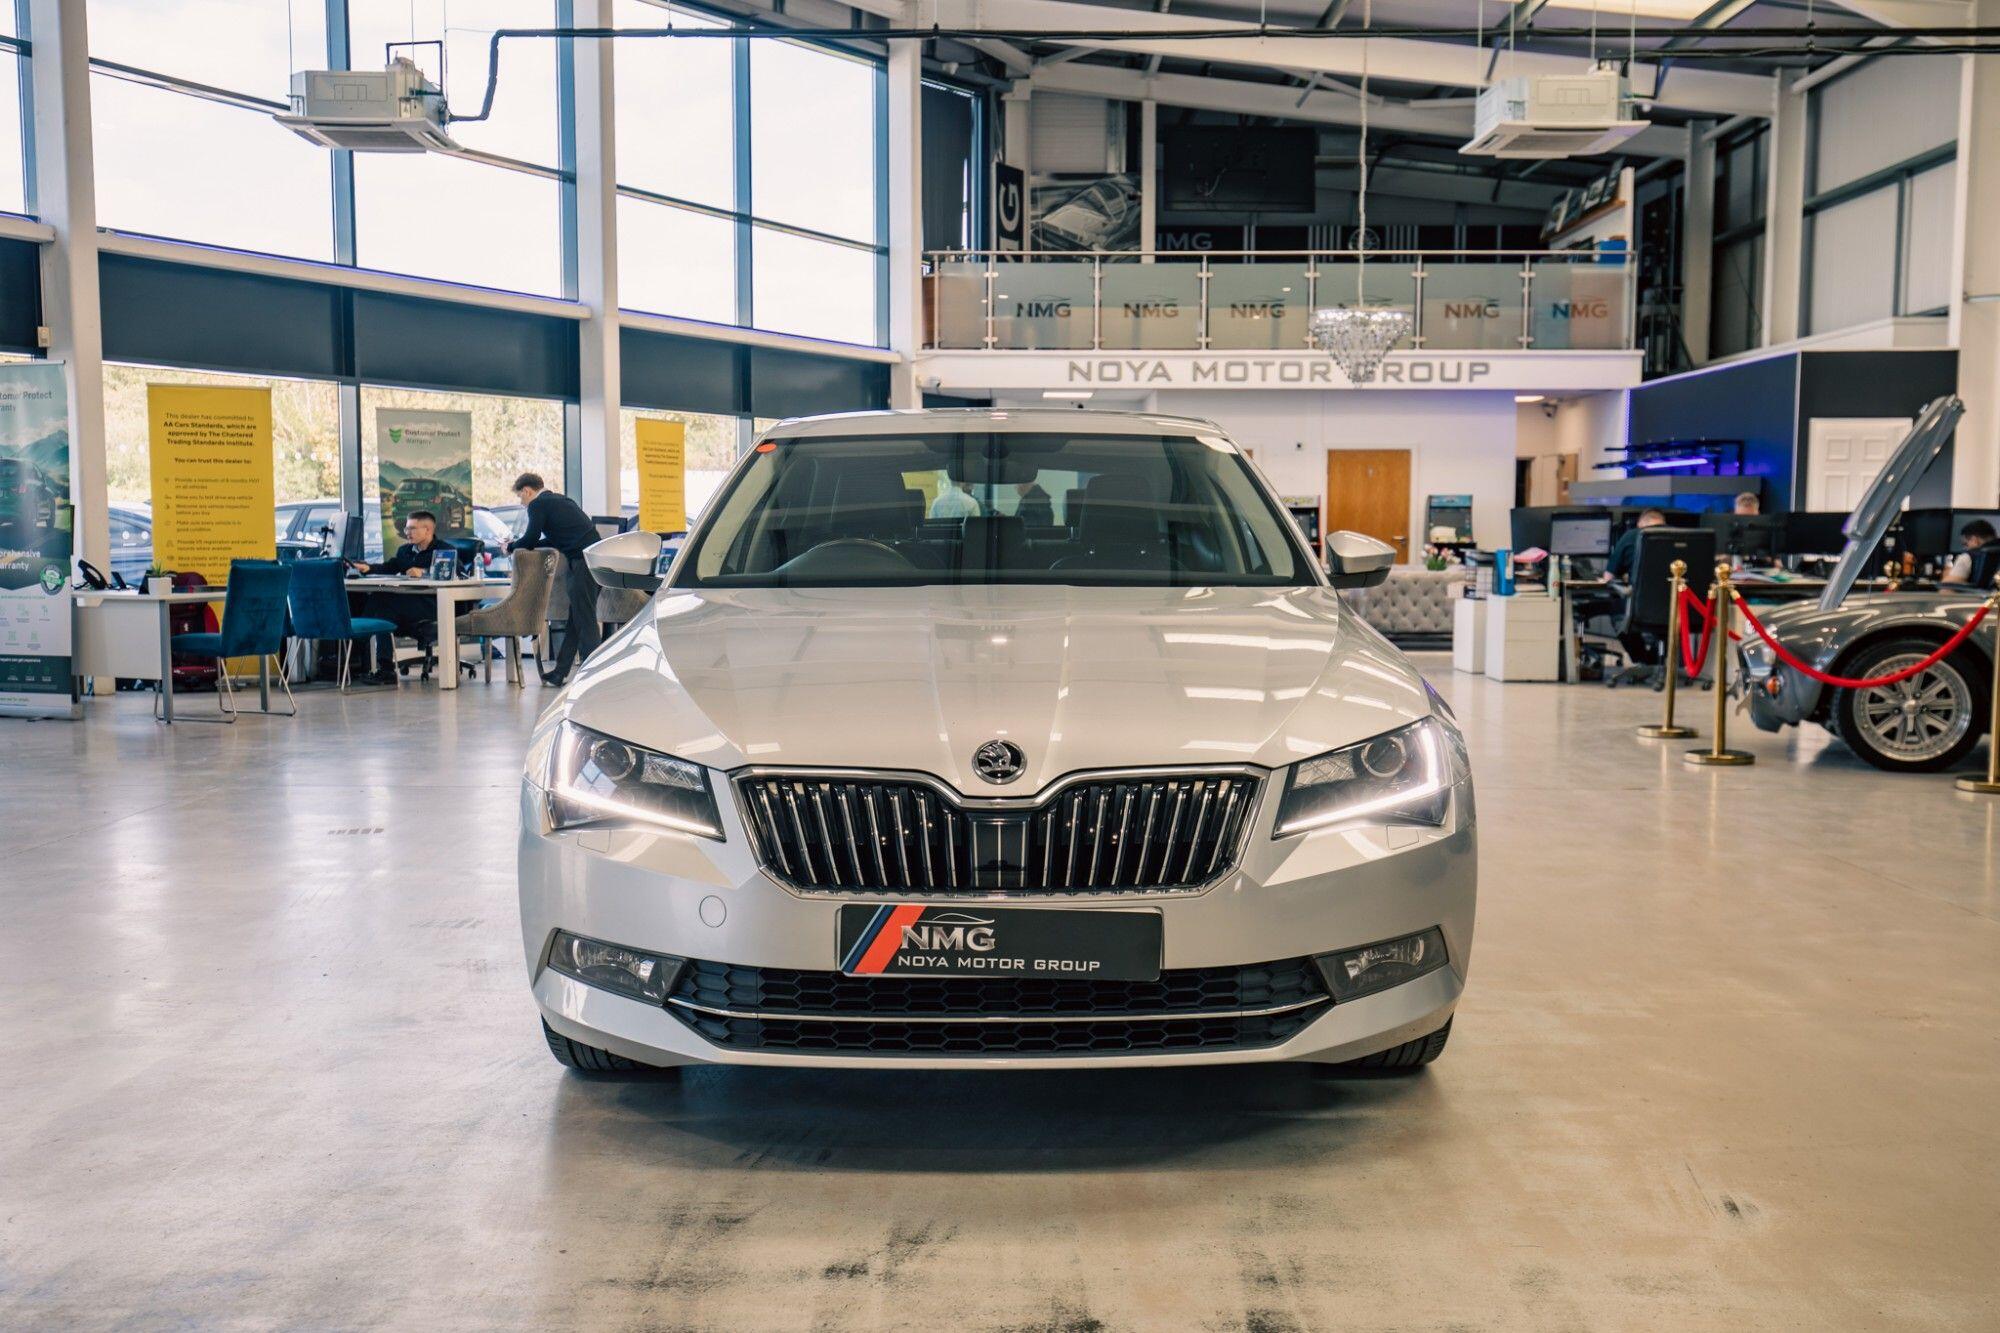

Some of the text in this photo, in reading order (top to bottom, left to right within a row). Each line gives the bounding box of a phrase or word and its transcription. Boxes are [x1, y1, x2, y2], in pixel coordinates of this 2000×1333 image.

[1016, 303, 1071, 318] NMG
[1124, 303, 1179, 318] NMG
[1230, 303, 1286, 318] NMG
[1444, 303, 1500, 319] NMG
[1552, 303, 1608, 319] NMG
[1068, 360, 1172, 382] NOYA
[1192, 360, 1331, 383] MOTOR
[23, 390, 52, 400] Protect
[168, 430, 199, 438] approved
[900, 925, 996, 951] NMG
[898, 955, 1100, 972] NOYA MOTOR GROUP
